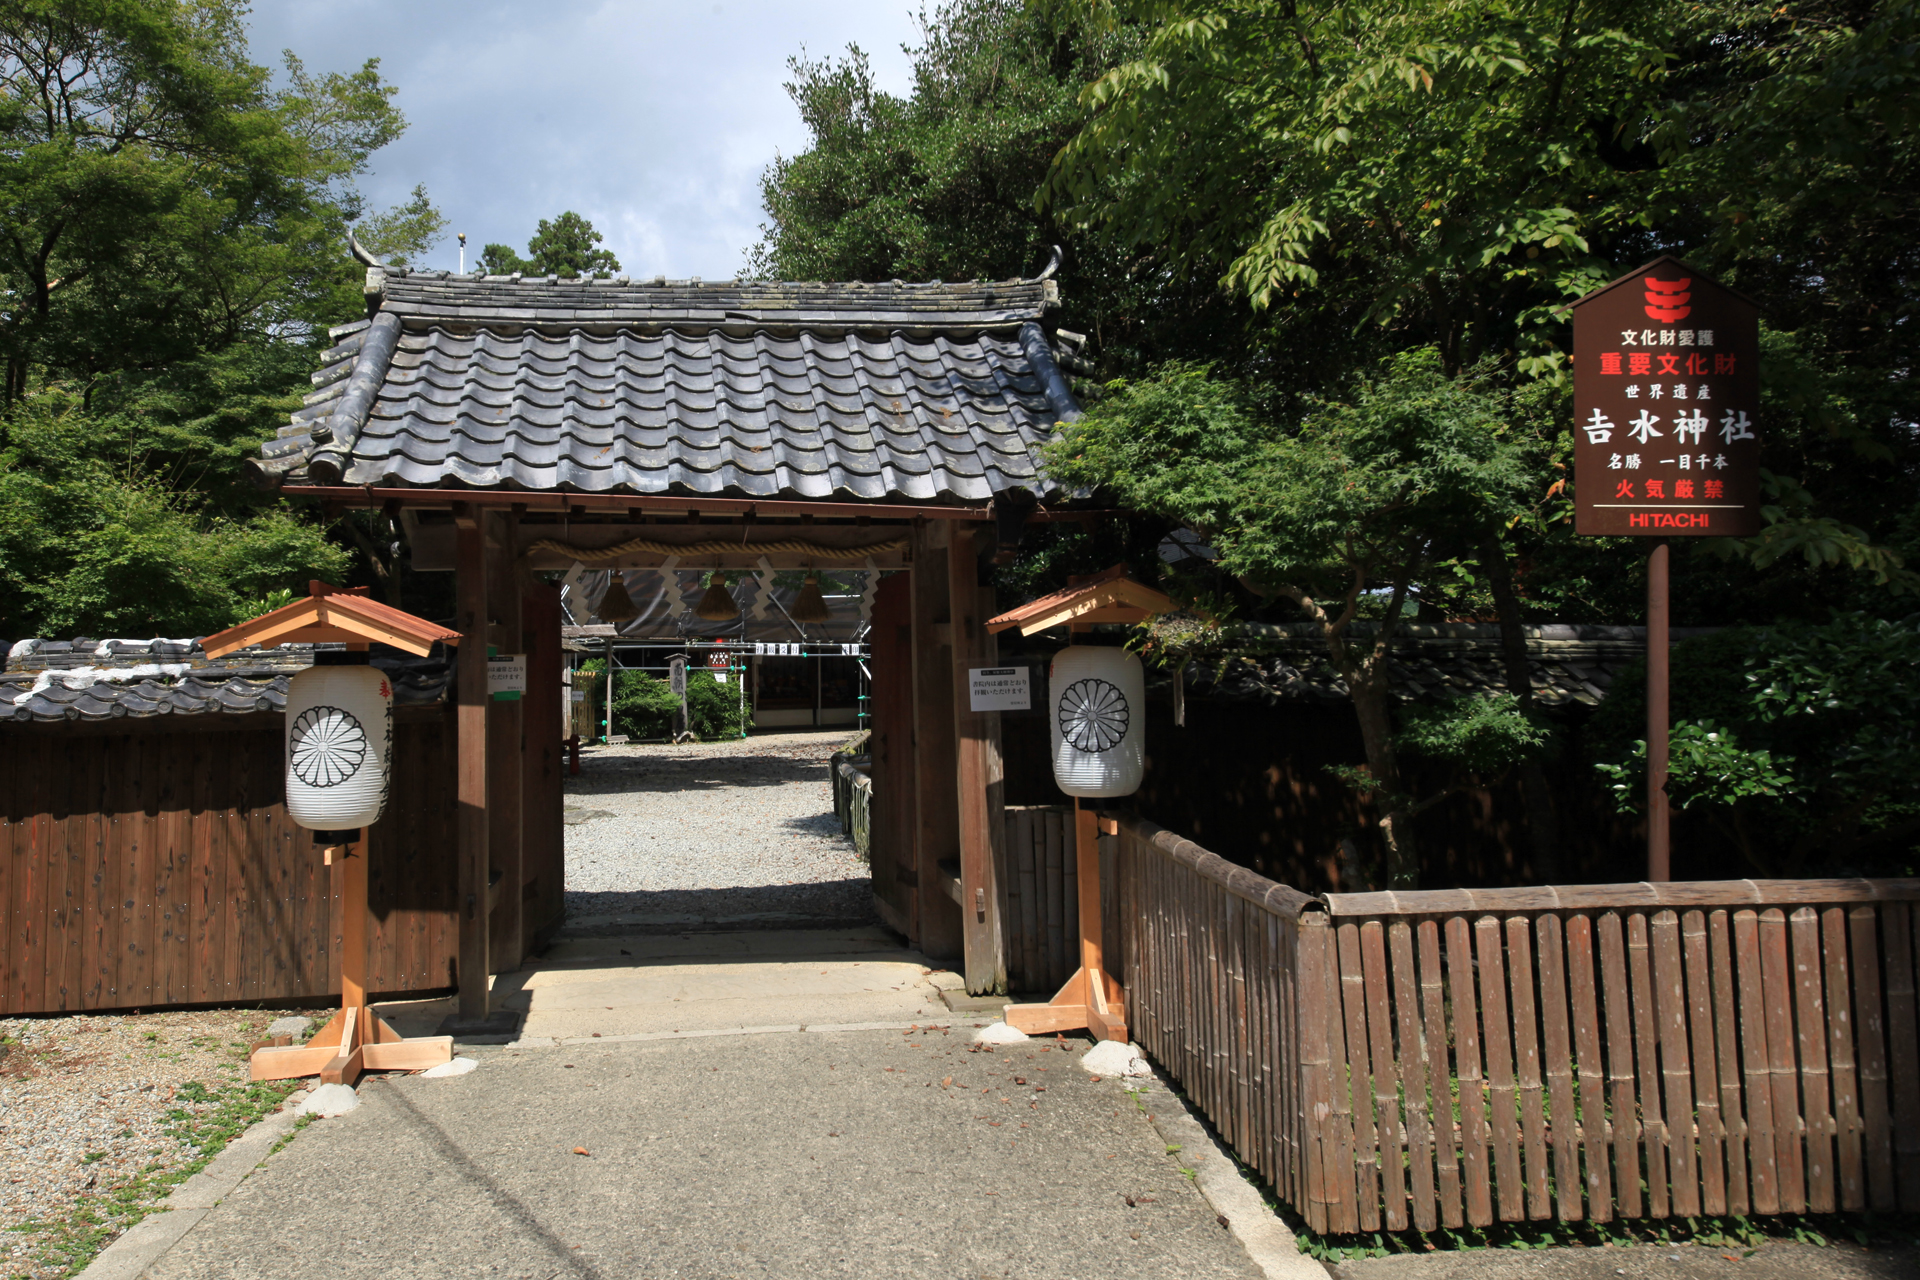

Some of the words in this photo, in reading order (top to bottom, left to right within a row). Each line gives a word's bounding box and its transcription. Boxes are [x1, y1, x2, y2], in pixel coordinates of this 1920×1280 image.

[1621, 329, 1714, 346] 文化財愛護
[1599, 352, 1737, 376] 重要文化財
[1625, 383, 1712, 400] 世界遺産
[1607, 453, 1643, 470] 名勝
[1659, 453, 1730, 470] 一目千本
[1615, 479, 1724, 499] 火気厳禁
[1629, 513, 1709, 528] HITACHI
